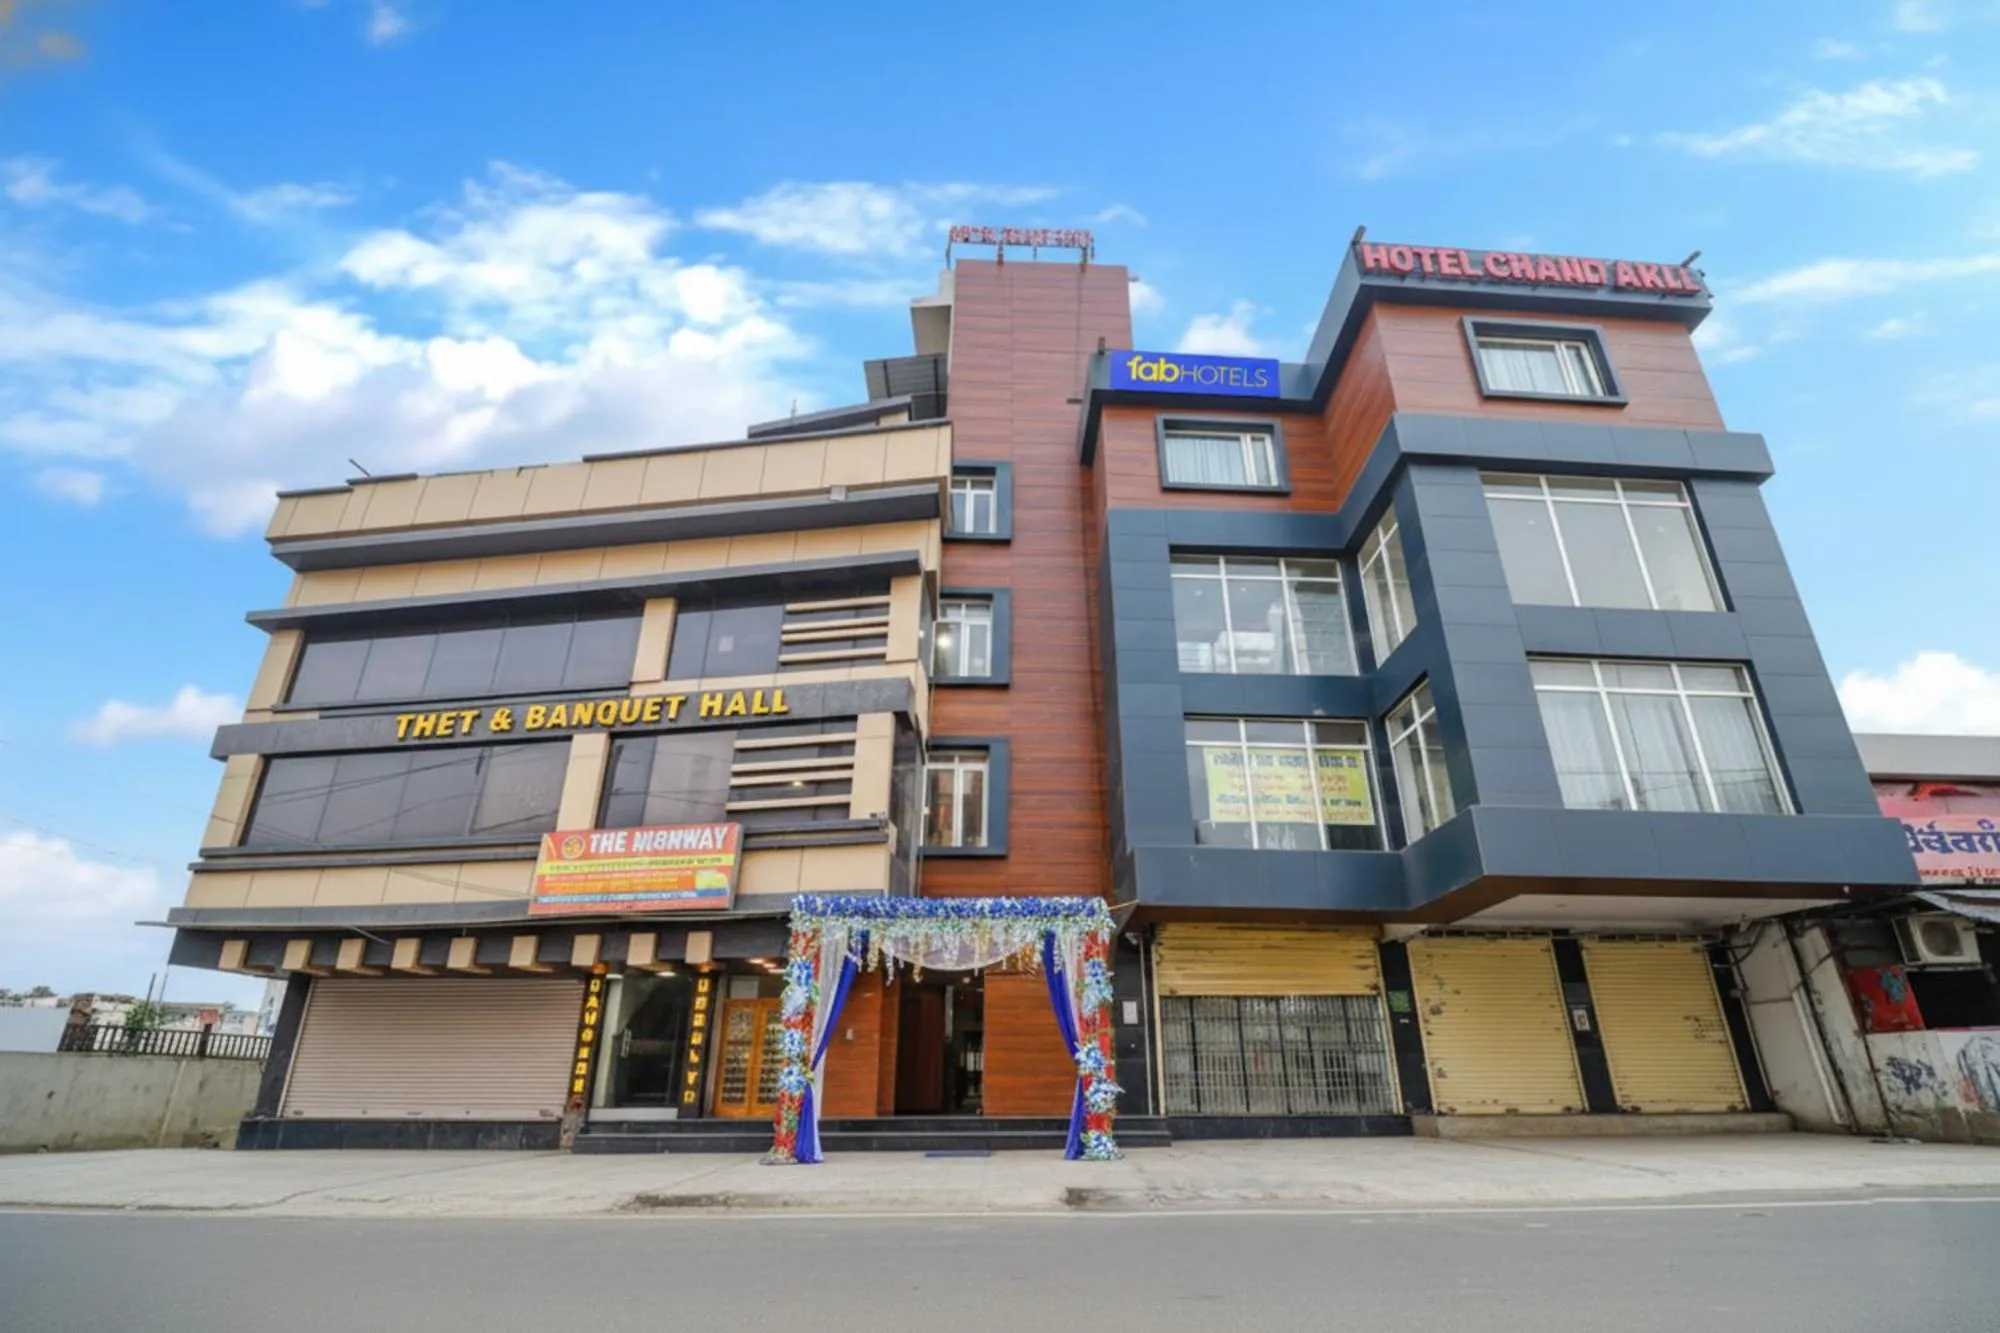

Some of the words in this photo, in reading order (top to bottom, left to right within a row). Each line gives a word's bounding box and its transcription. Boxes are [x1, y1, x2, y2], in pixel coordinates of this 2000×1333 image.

[1361, 242, 1482, 278] HOTEL
[395, 708, 481, 741] THET
[489, 707, 513, 732] &
[524, 695, 686, 729] BANQUET
[700, 687, 789, 717] HALL
[589, 831, 629, 853] THE
